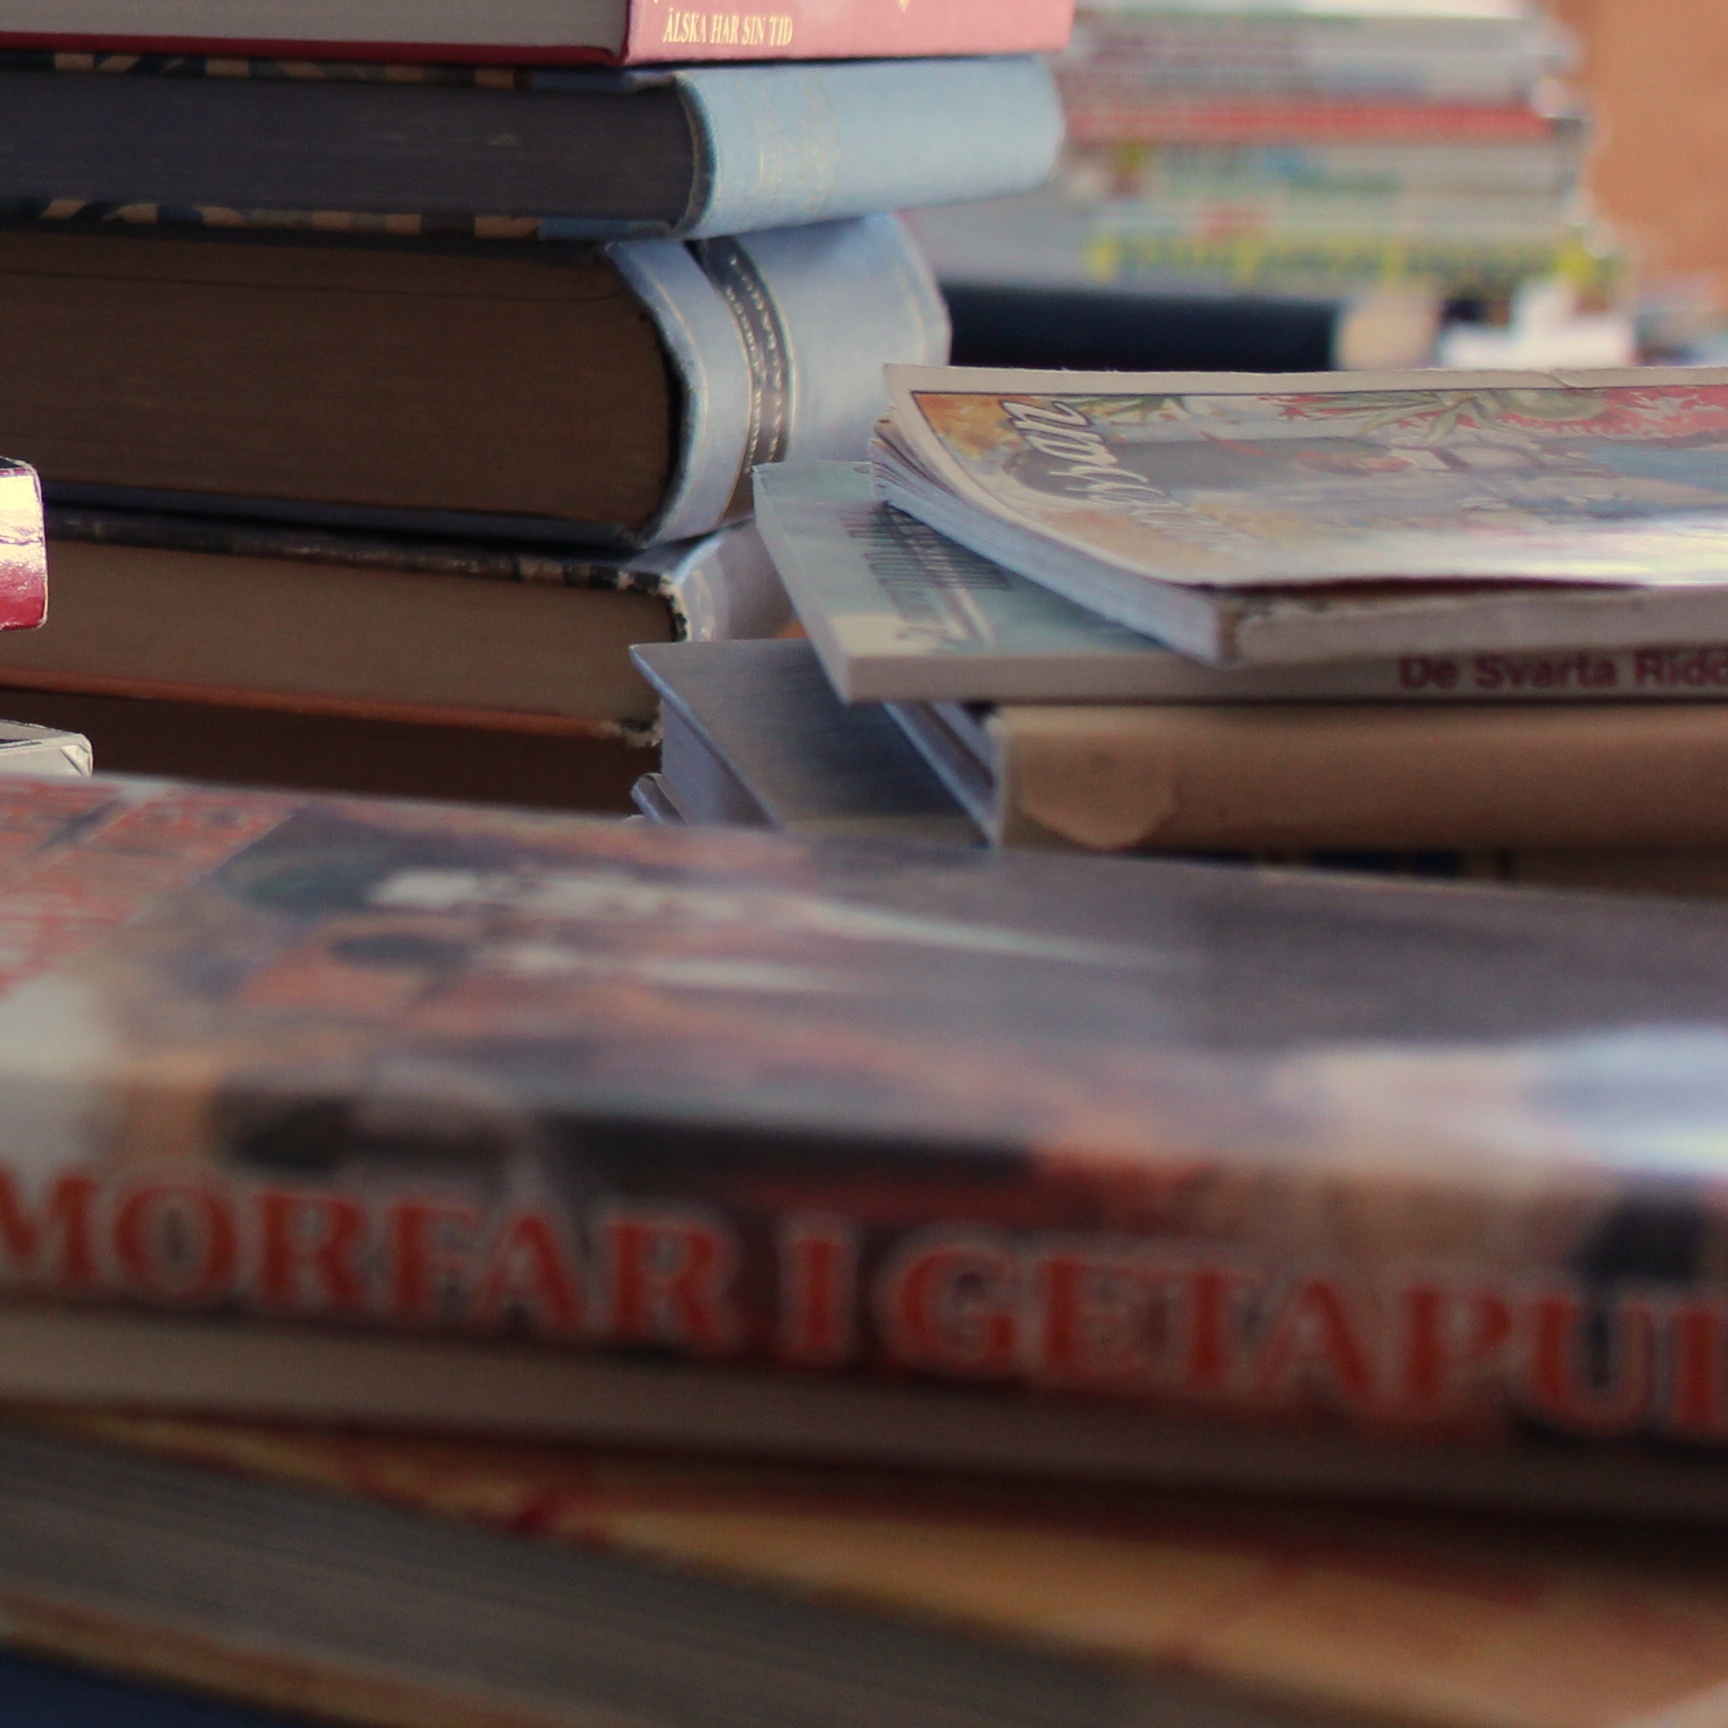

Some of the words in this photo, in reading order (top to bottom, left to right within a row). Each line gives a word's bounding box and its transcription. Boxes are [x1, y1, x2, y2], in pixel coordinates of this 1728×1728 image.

[710, 13, 740, 44] HAR
[741, 14, 767, 46] SIN
[768, 15, 794, 47] TID
[1397, 653, 1459, 690] De
[1472, 648, 1618, 690] Svarta
[782, 1230, 854, 1364] I
